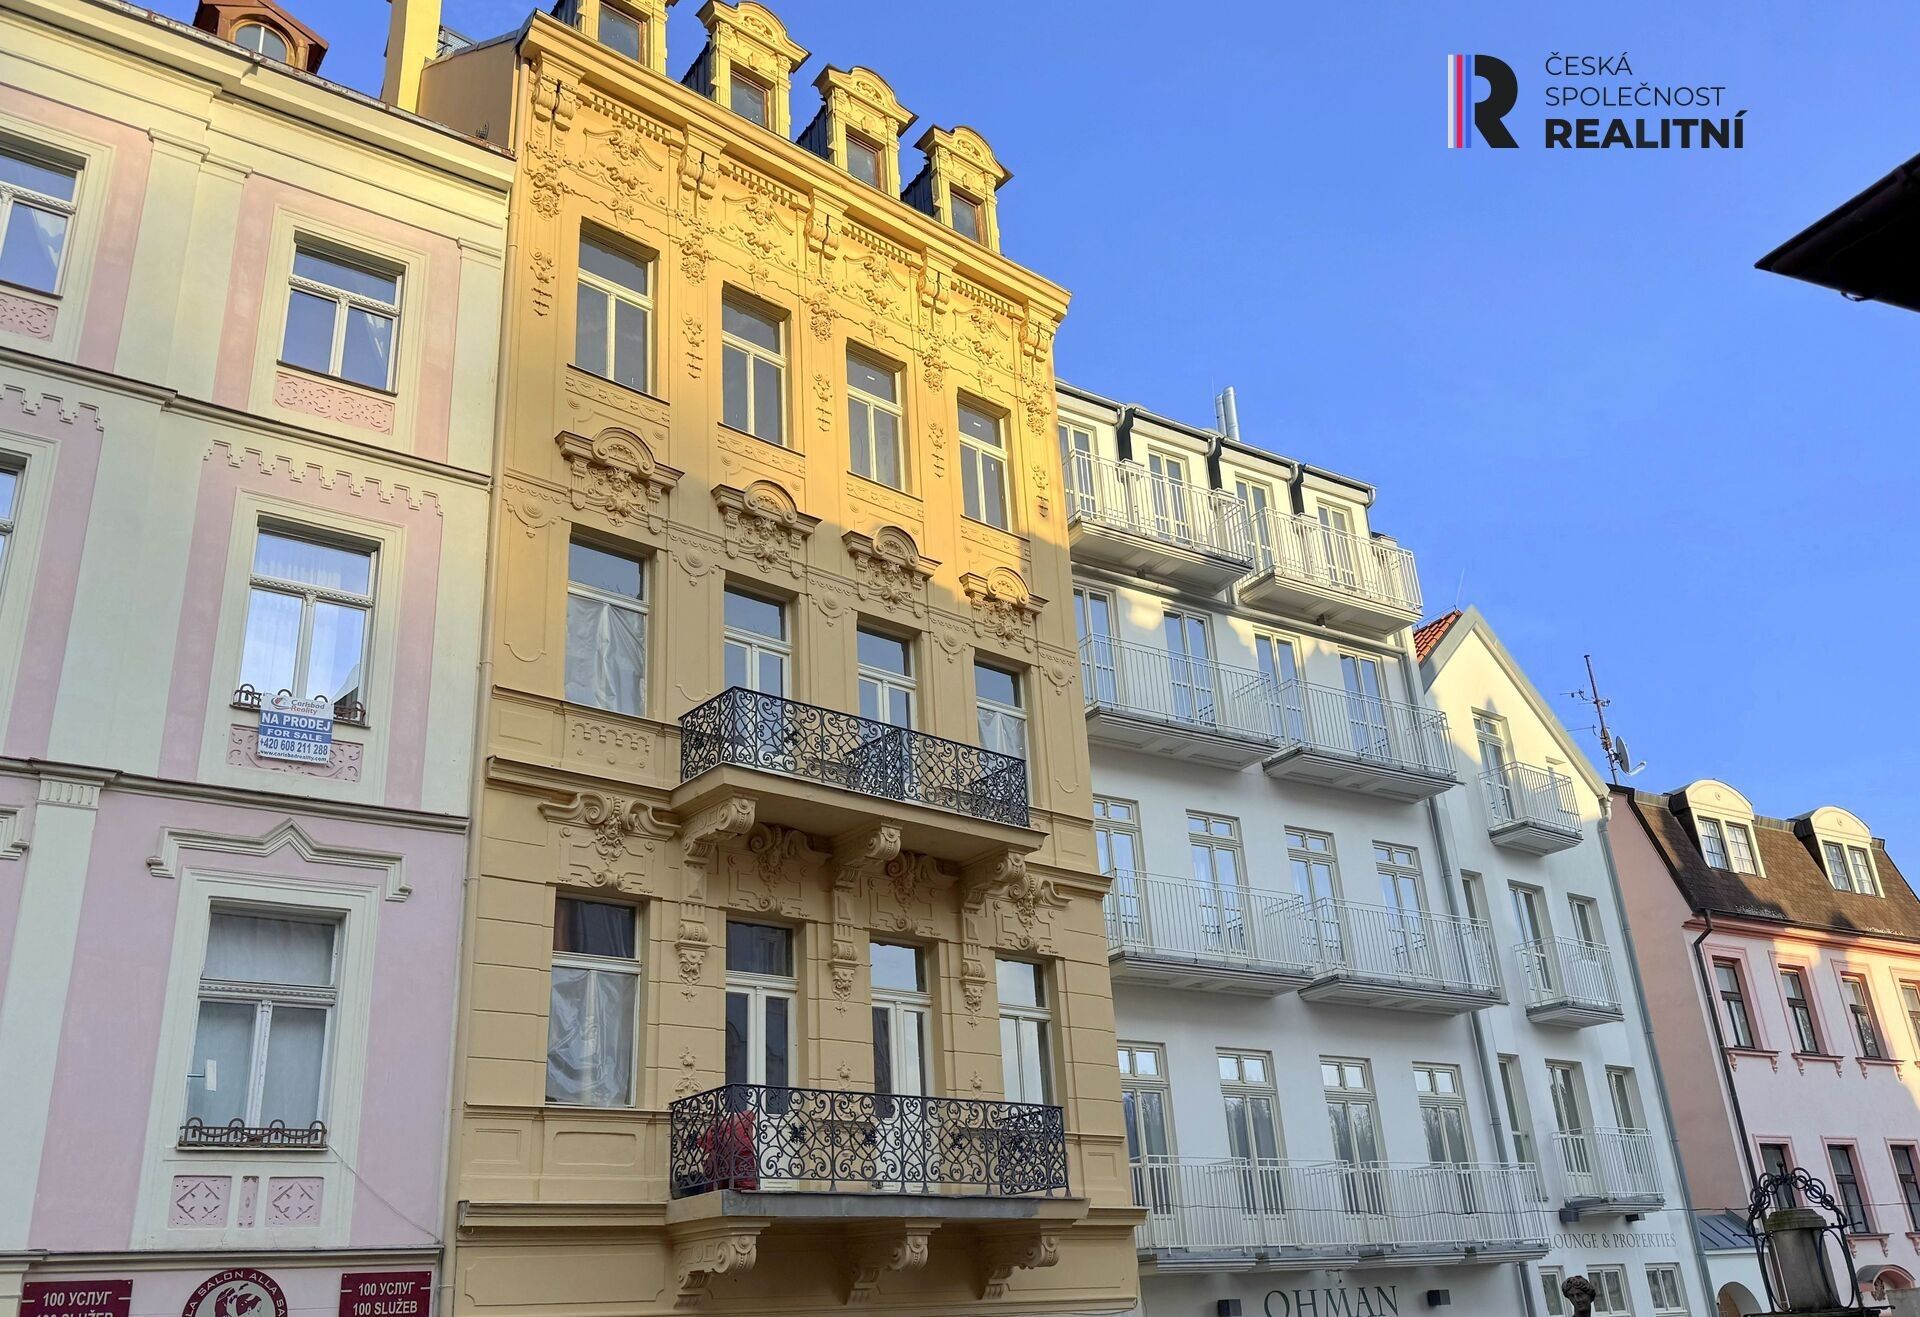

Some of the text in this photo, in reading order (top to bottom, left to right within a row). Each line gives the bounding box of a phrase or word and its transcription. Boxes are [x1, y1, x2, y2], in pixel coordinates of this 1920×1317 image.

[290, 705, 318, 716] Reality
[291, 699, 326, 710] Carlsbad
[261, 712, 331, 732] NA PRODEJ
[267, 728, 323, 742] FOR SALE
[260, 737, 328, 756] +420 608 211 288
[1602, 1233, 1610, 1249] &
[1613, 1232, 1677, 1249] PROPERTIES
[198, 1271, 244, 1297] SALON
[249, 1272, 278, 1295] ALLA
[358, 1281, 416, 1296] 100 УСЛУГ
[42, 1291, 113, 1307] 100 УСЛУГ
[353, 1298, 418, 1316] 100 SLUŽEB
[1264, 1285, 1398, 1317] OHMAN
